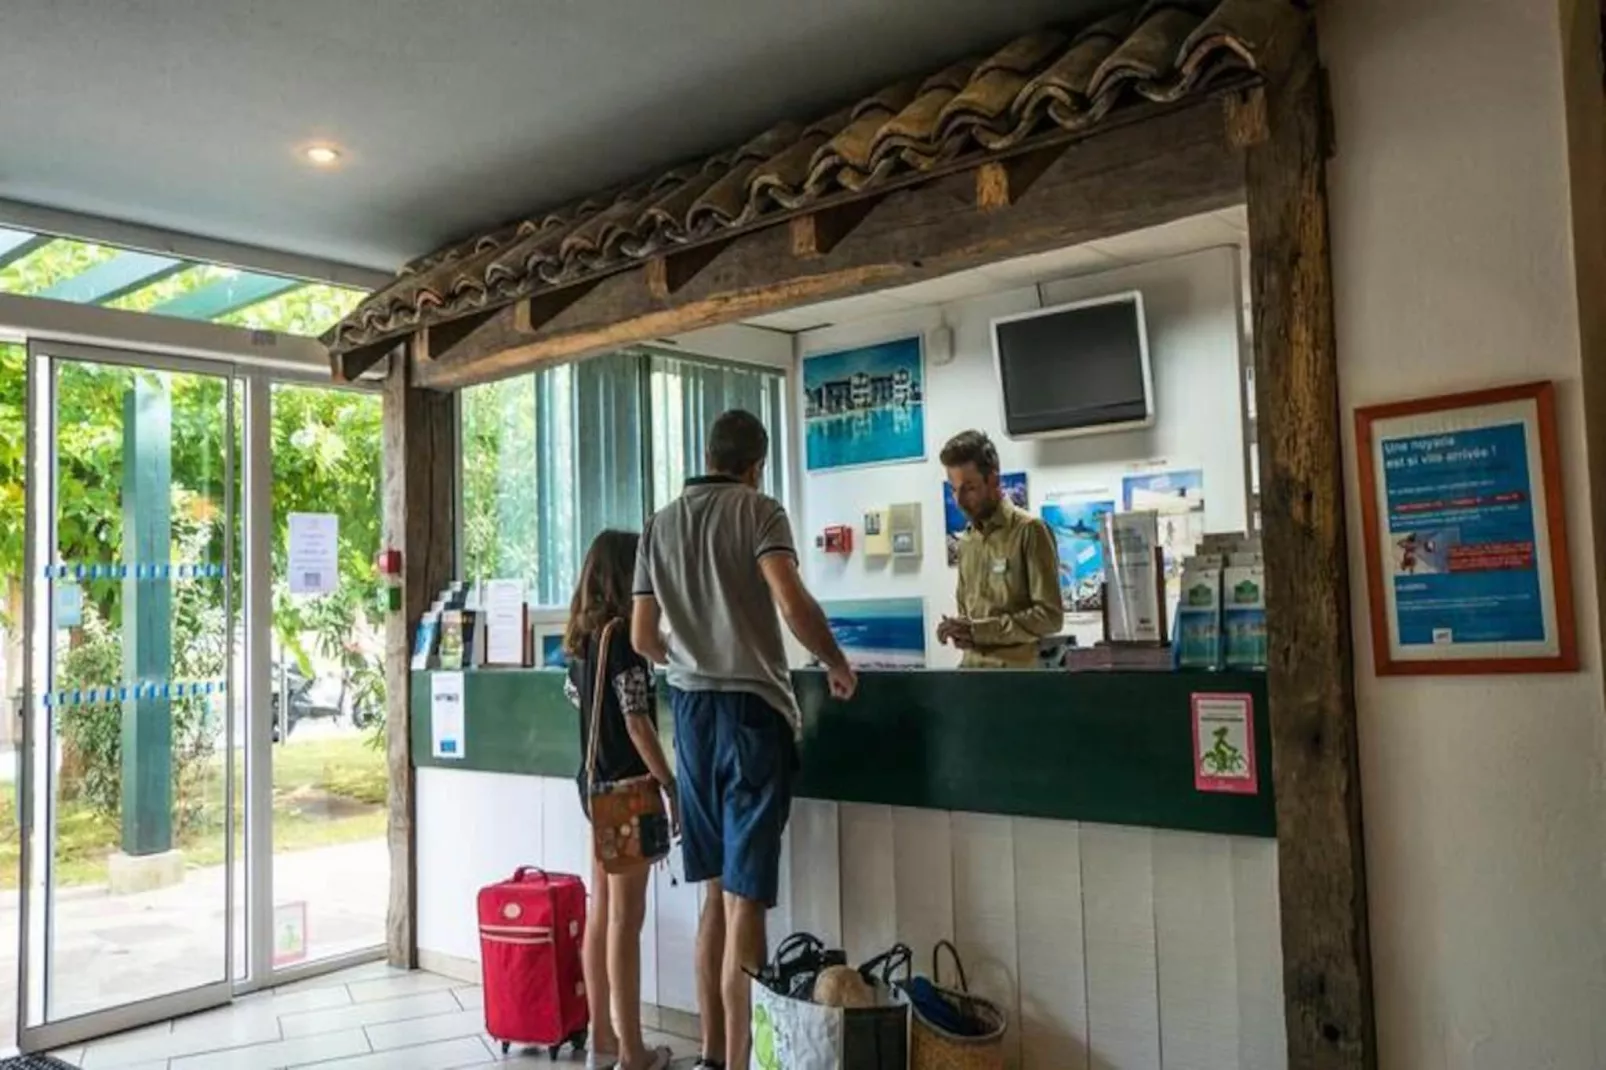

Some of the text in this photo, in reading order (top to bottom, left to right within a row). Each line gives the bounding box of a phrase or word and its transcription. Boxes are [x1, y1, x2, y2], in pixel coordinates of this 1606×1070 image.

[1384, 442, 1408, 454] Une
[1386, 457, 1405, 469] est
[1407, 454, 1418, 467] si
